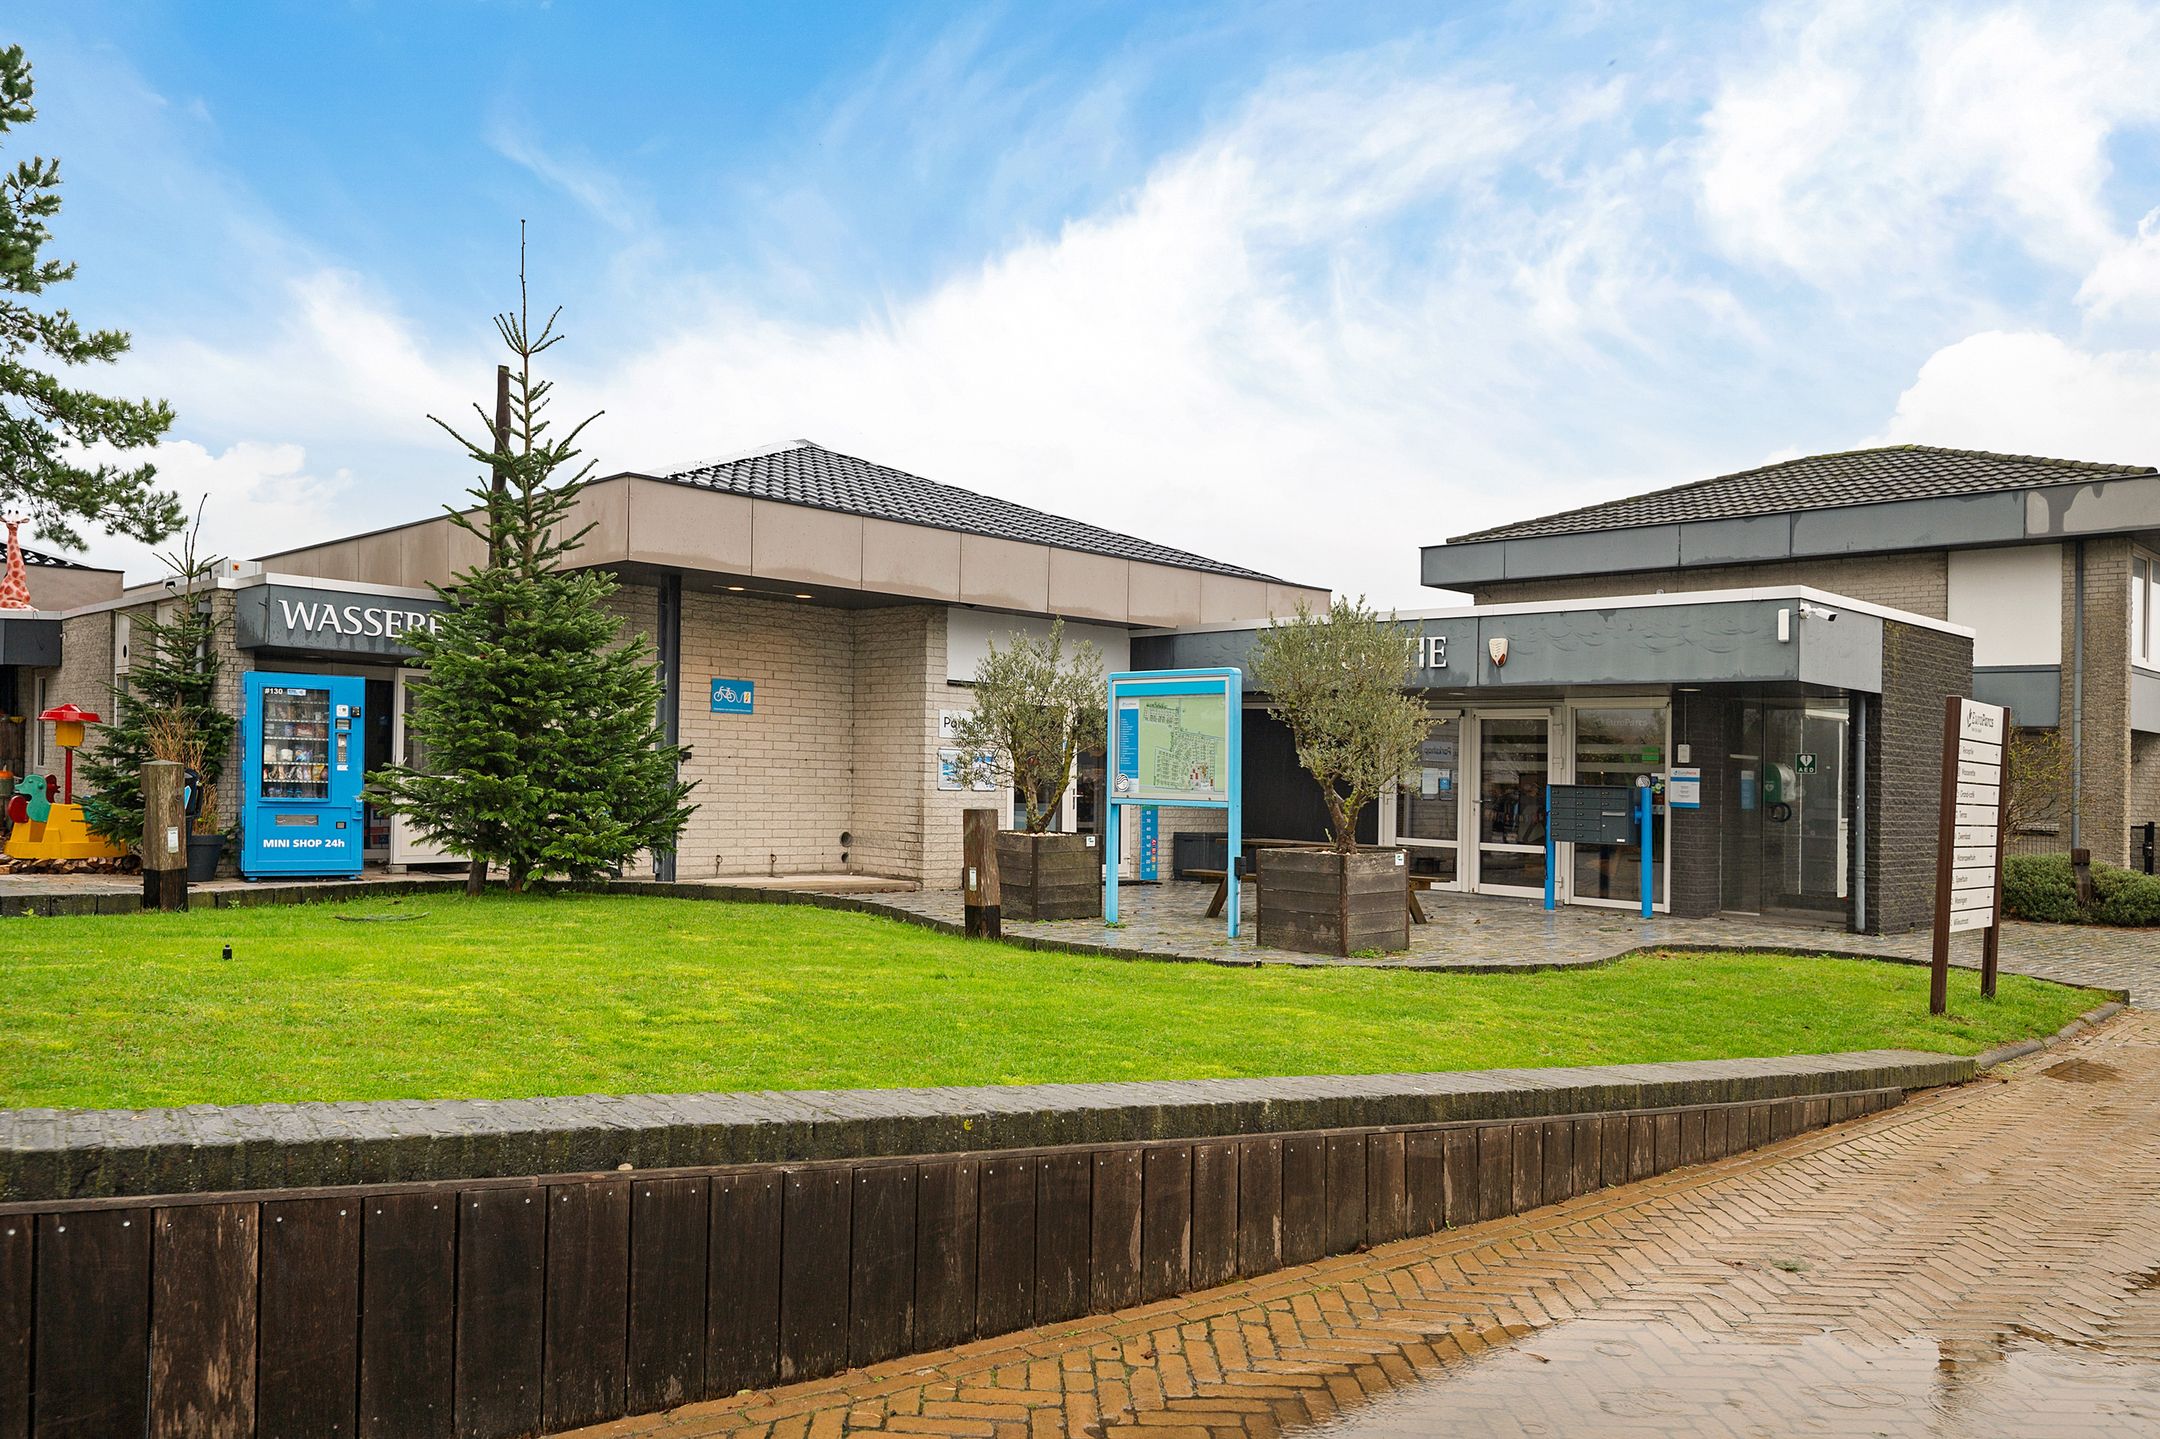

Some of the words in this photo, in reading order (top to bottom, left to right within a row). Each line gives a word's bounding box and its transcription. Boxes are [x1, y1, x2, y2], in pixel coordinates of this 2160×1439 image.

[278, 600, 456, 642] WASSERE
[263, 839, 290, 848] MINI
[293, 839, 322, 848] SHOP
[325, 838, 345, 848] 24h
